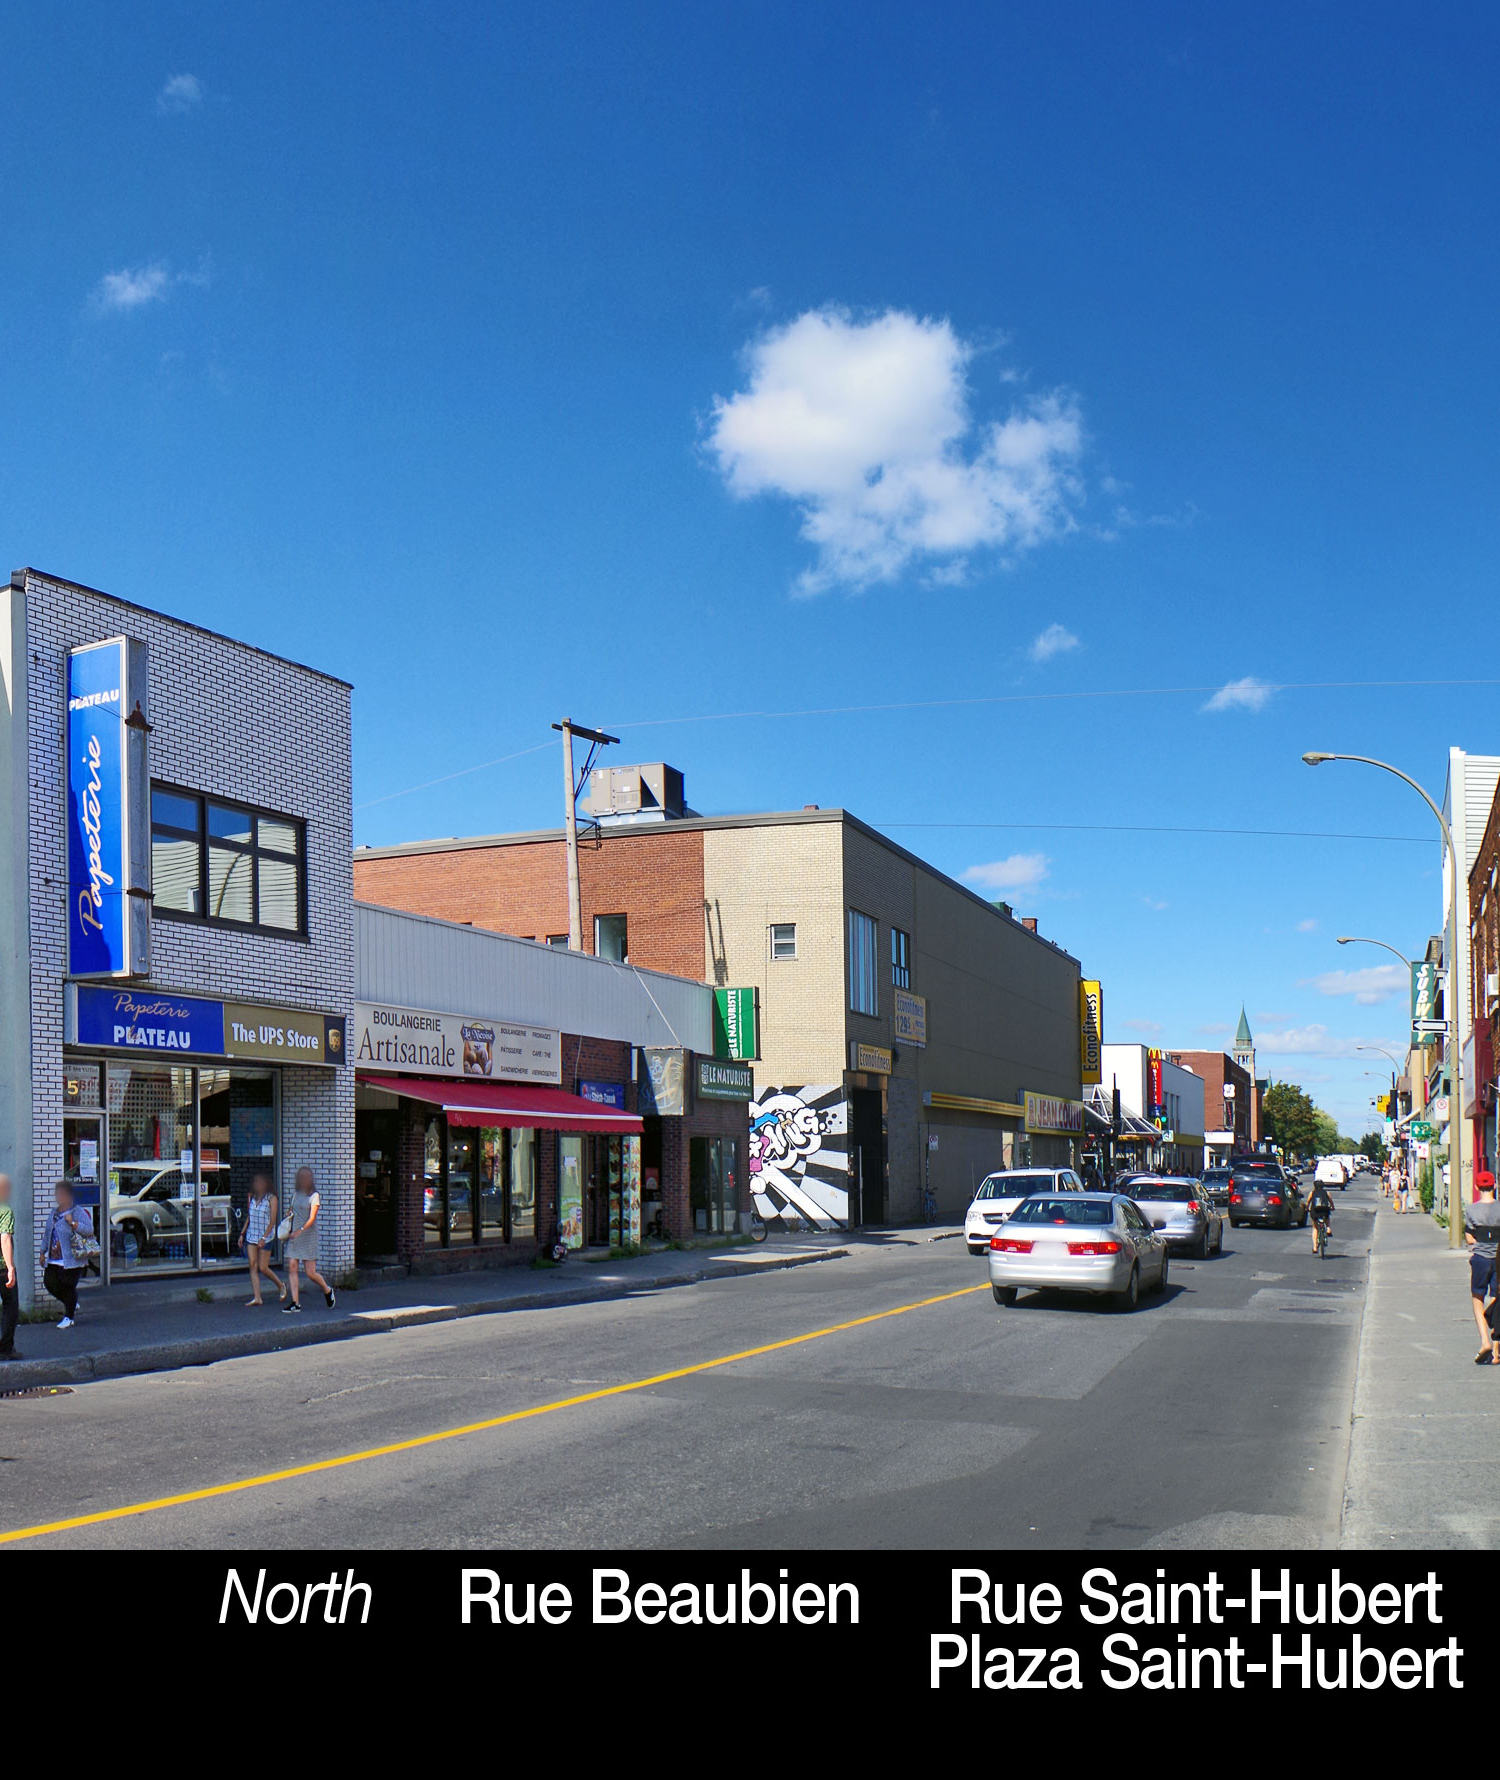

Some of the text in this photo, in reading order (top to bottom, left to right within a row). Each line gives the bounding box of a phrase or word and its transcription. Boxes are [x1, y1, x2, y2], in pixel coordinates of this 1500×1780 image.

[68, 688, 120, 712] PLATEAU
[78, 734, 114, 936] Papeterie
[113, 992, 191, 1022] Papeterie
[1414, 963, 1432, 1043] SUBWY
[373, 1010, 441, 1032] BOULANGERIE
[500, 1027, 527, 1037] BOULANGERIE
[727, 990, 737, 1048] LE NATURISTE
[1082, 993, 1098, 1072] Econofitness
[113, 1025, 191, 1049] PLATEAU
[232, 1022, 319, 1050] The UPS Store
[357, 1027, 455, 1068] Artisanale
[859, 1046, 891, 1072] Econofitness
[67, 1079, 79, 1096] 5
[709, 1066, 751, 1087] LE NATURISTE
[1037, 1098, 1058, 1127] JEAN
[1058, 1102, 1082, 1130] COUTU
